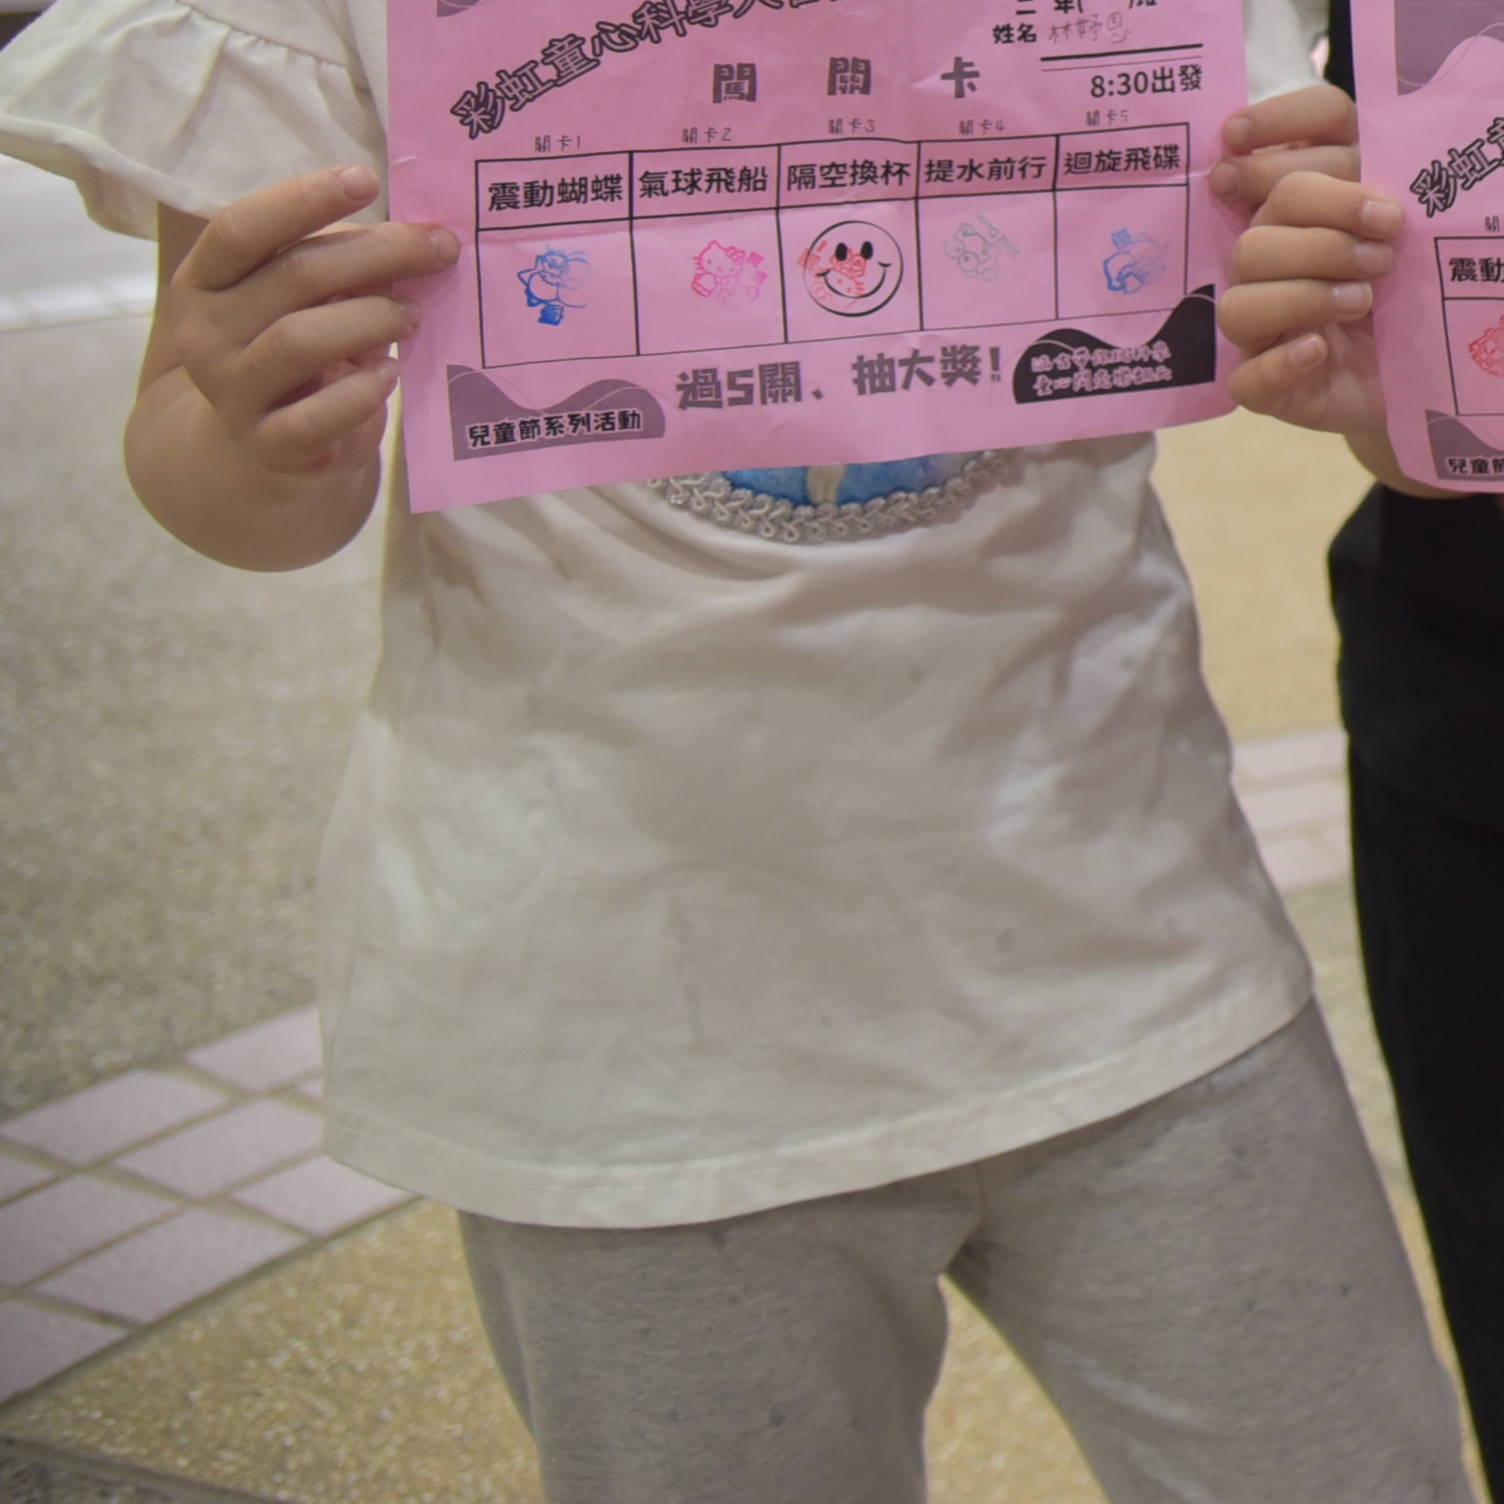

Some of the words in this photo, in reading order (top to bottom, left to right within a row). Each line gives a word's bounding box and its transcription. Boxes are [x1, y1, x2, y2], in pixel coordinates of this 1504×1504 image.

[992, 23, 1038, 45] 姓名
[1090, 64, 1203, 98] 8:30出發
[828, 118, 877, 135] 關卡3
[958, 119, 1006, 136] 關卡4
[1086, 109, 1131, 127] 關卡5
[534, 135, 582, 153] 關卡1
[681, 127, 733, 145] 關卡2
[923, 156, 1047, 184] 提水前行
[1063, 143, 1181, 176] 迴旋飛碟
[638, 165, 768, 199] 氣球飛船
[786, 159, 912, 192] 隔空換杯
[487, 173, 624, 212] 震動蝴蝶
[468, 410, 642, 447] 兒童節系列活動
